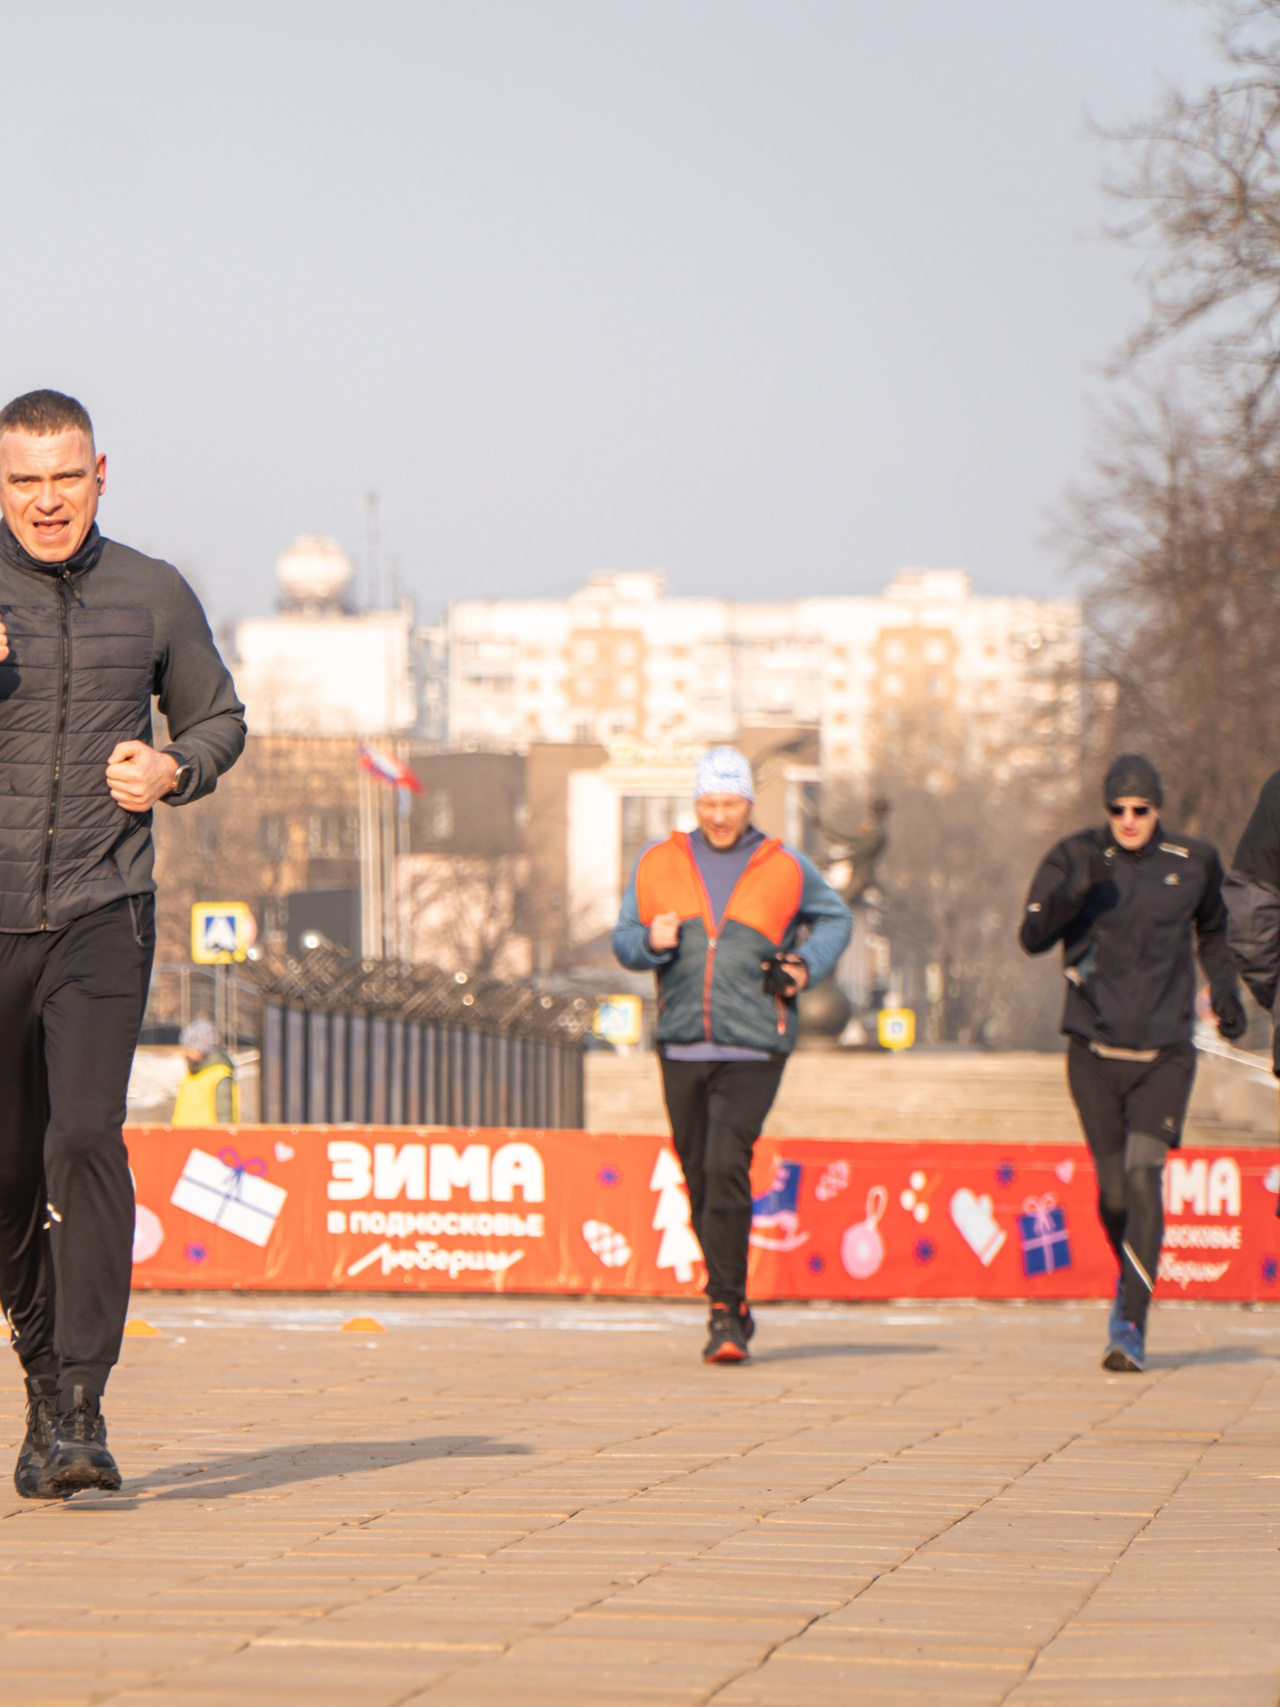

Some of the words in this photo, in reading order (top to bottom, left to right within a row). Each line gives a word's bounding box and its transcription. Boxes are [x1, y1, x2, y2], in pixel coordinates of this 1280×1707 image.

[327, 1140, 545, 1202] ЗИМА
[1161, 1157, 1241, 1216] МА
[327, 1210, 347, 1234] В
[347, 1241, 525, 1278] Люберцы
